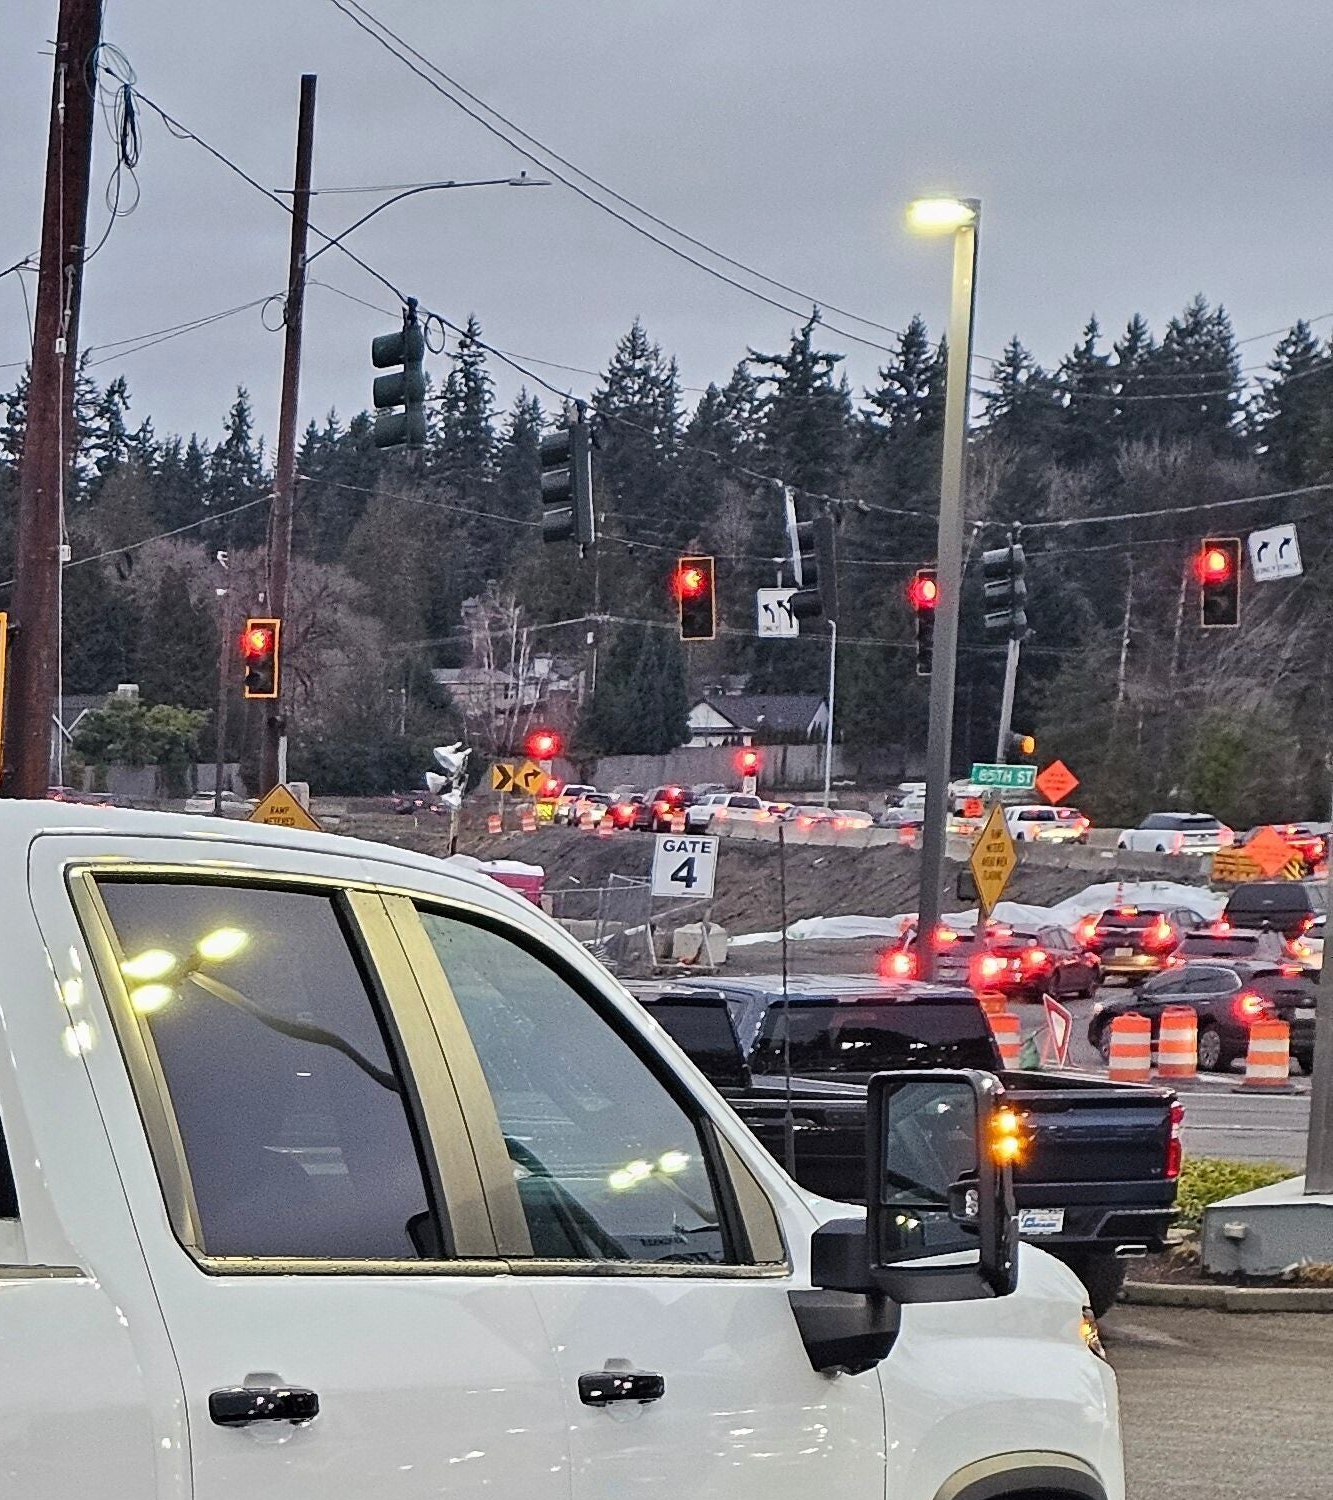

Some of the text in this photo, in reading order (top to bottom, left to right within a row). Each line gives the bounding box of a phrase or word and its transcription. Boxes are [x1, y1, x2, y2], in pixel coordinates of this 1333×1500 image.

[1017, 770, 1033, 785] ST
[270, 806, 290, 814] RAMP
[663, 840, 712, 854] GATE
[671, 857, 698, 888] 4
